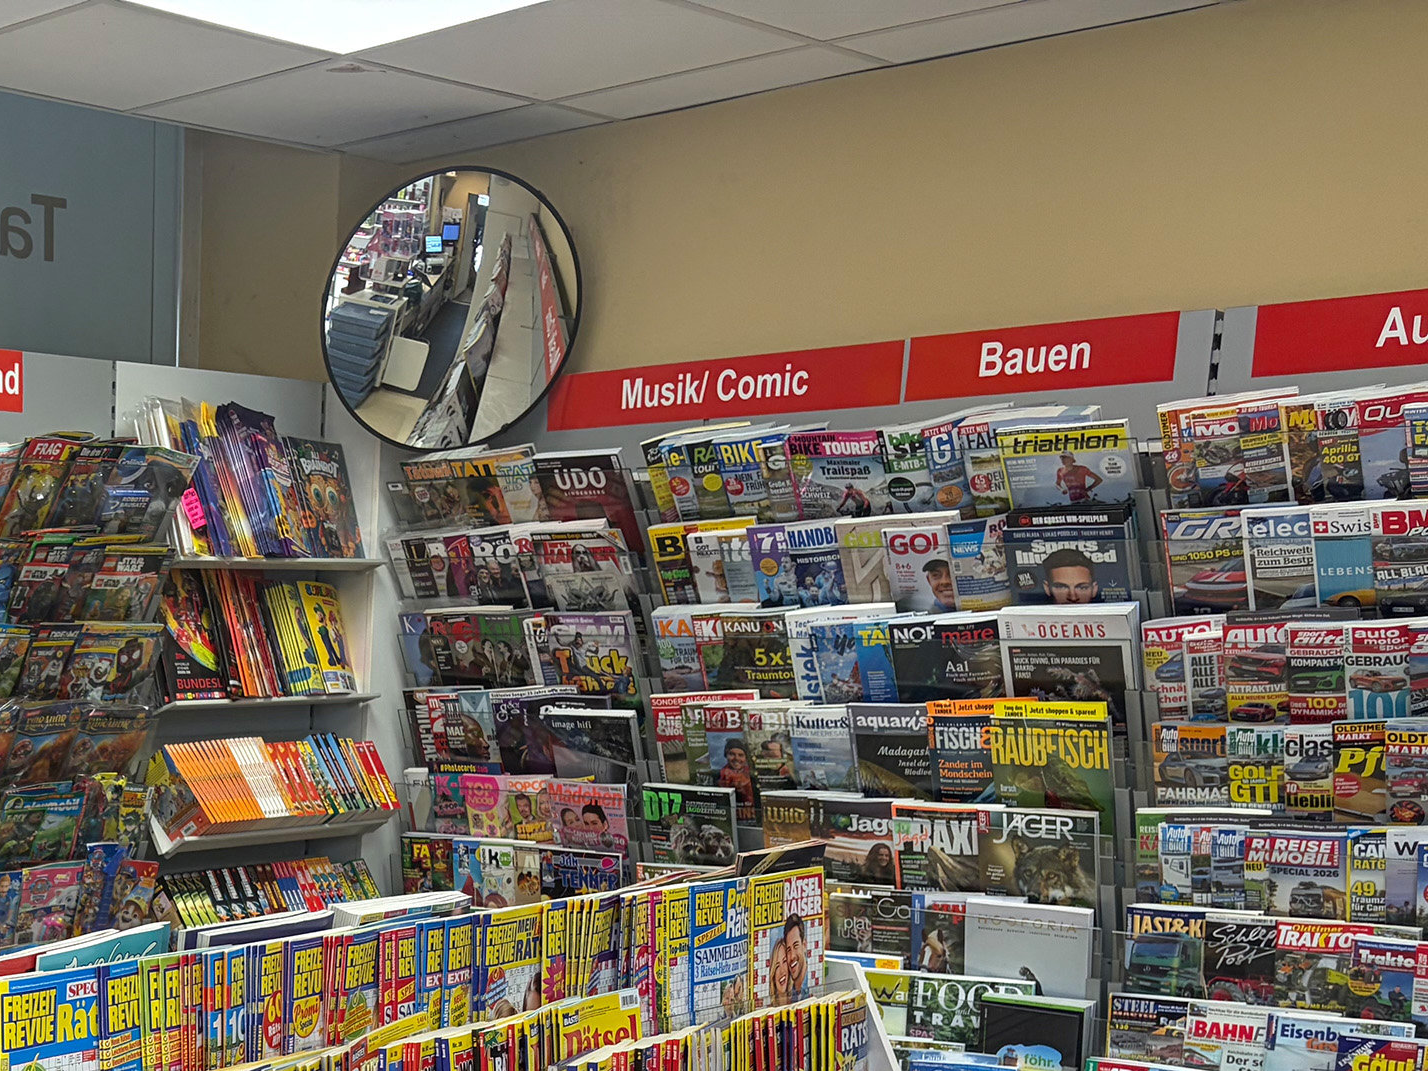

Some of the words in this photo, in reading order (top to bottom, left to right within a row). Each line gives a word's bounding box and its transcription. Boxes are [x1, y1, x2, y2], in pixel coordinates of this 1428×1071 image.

[979, 336, 1091, 378] Bauen
[621, 371, 711, 409] Musik/
[716, 368, 808, 401] Comic
[33, 443, 62, 455] FRAG
[790, 443, 822, 456] BIKE
[1012, 433, 1119, 454] triathlon
[1322, 444, 1357, 455] Aprilia
[302, 457, 339, 476] BRAINROT
[820, 465, 871, 477] Trailspaß
[554, 466, 607, 490] UDO
[889, 533, 939, 555] GO!
[117, 563, 144, 572] WARS
[122, 557, 144, 565] STAR
[942, 628, 994, 645] mare
[1038, 623, 1106, 638] OCEANS
[946, 660, 969, 672] Aal
[1191, 657, 1215, 666] ALLE
[552, 719, 574, 729] image
[577, 719, 592, 729] hifi
[991, 728, 1110, 770] RAUBFISCH
[938, 759, 968, 769] Zander
[939, 769, 993, 779] Mondschein
[1231, 781, 1278, 804] GTI
[993, 813, 1074, 844] JÄGER
[1275, 838, 1333, 853] REISE
[1271, 850, 1333, 867] MOBIL
[560, 869, 618, 889] TENNER
[1271, 866, 1310, 877] SPECIAL
[1312, 870, 1339, 878] 2026
[784, 874, 820, 897] RÄTSEL
[784, 897, 822, 919] KAISER
[1194, 1020, 1254, 1041] BAHN
[1024, 1054, 1055, 1068] föhr.
